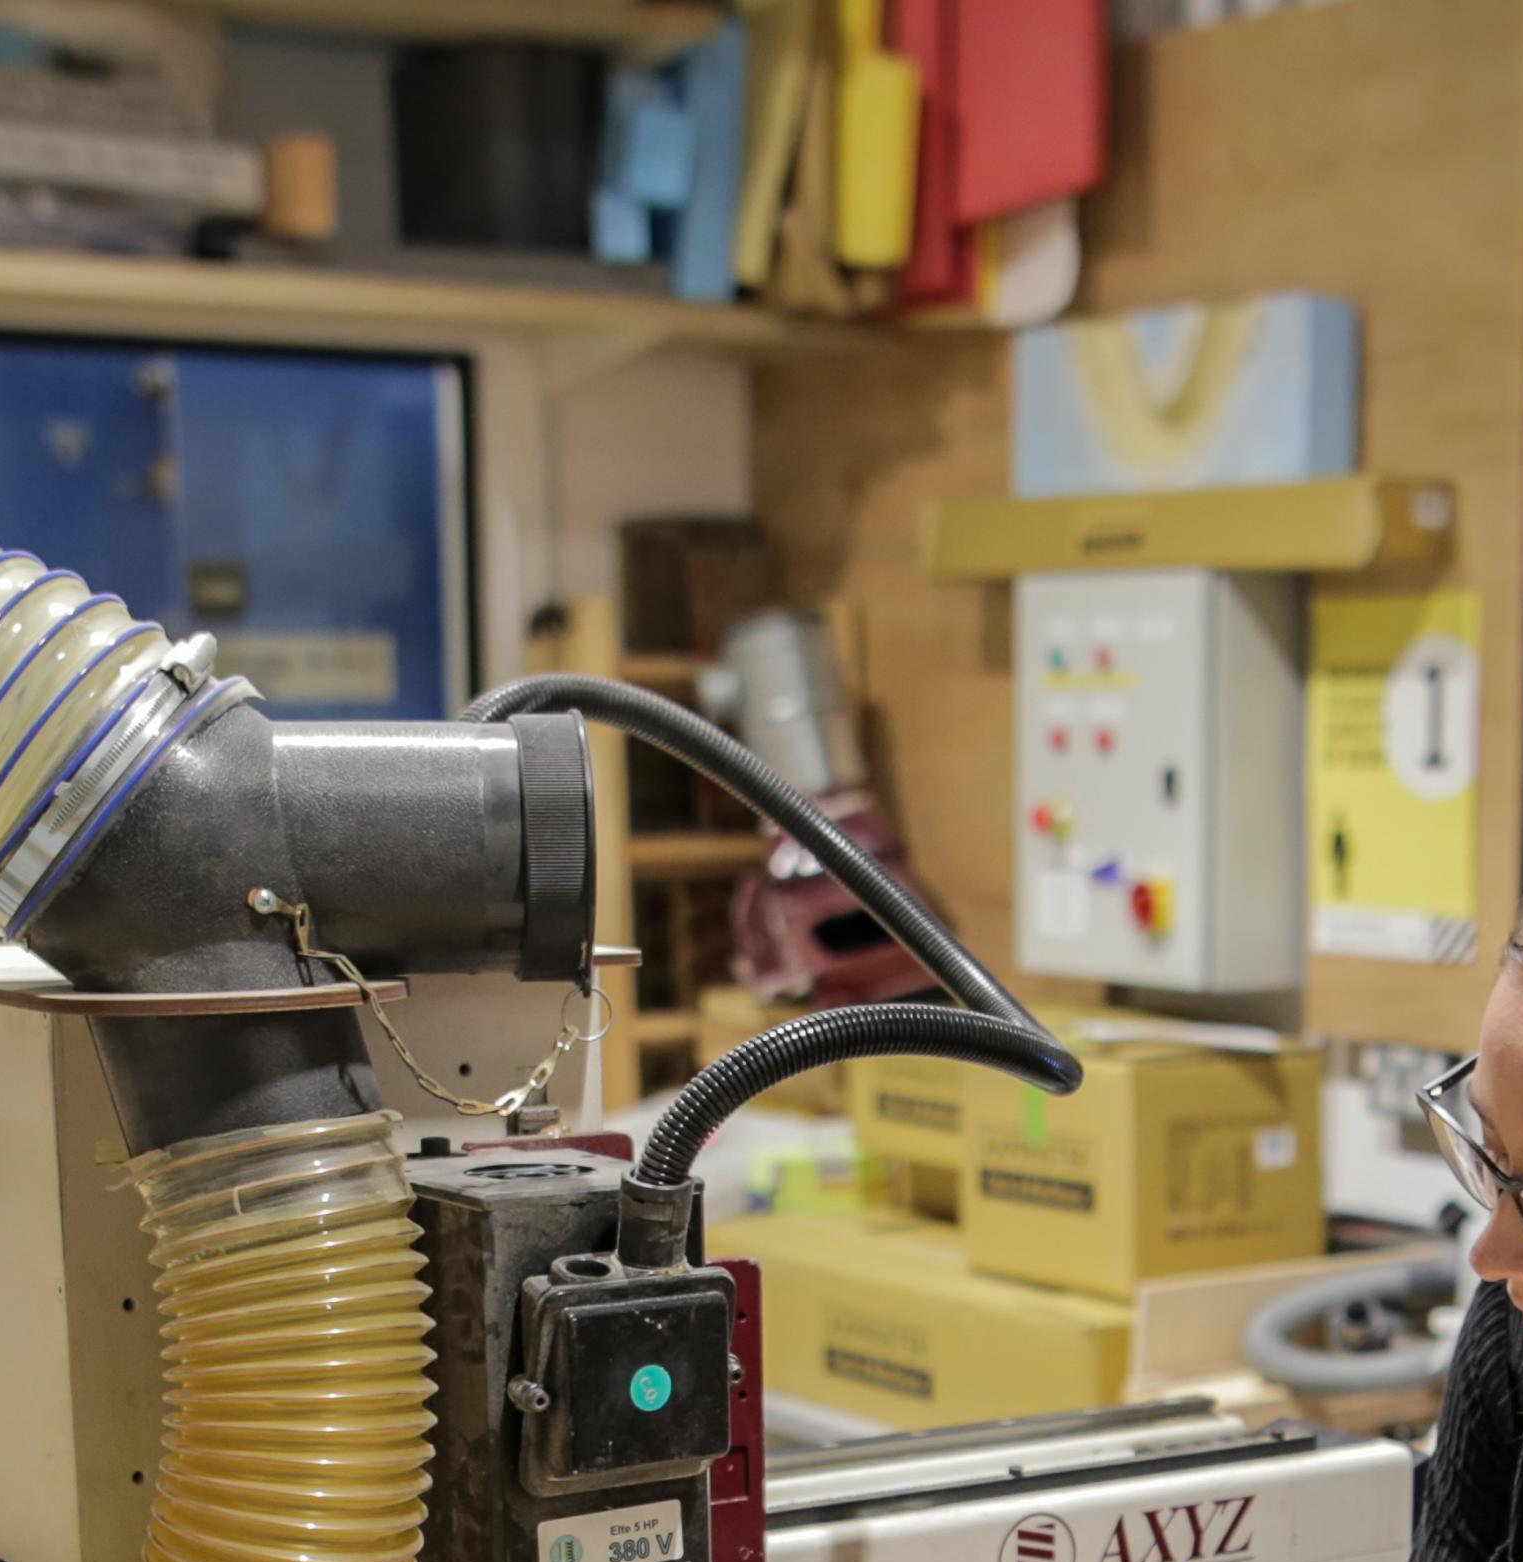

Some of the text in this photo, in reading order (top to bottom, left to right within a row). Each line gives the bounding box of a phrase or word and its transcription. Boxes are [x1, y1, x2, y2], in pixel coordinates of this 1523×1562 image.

[634, 1521, 640, 1532] 5
[643, 1518, 659, 1531] HP
[655, 1532, 673, 1555] V
